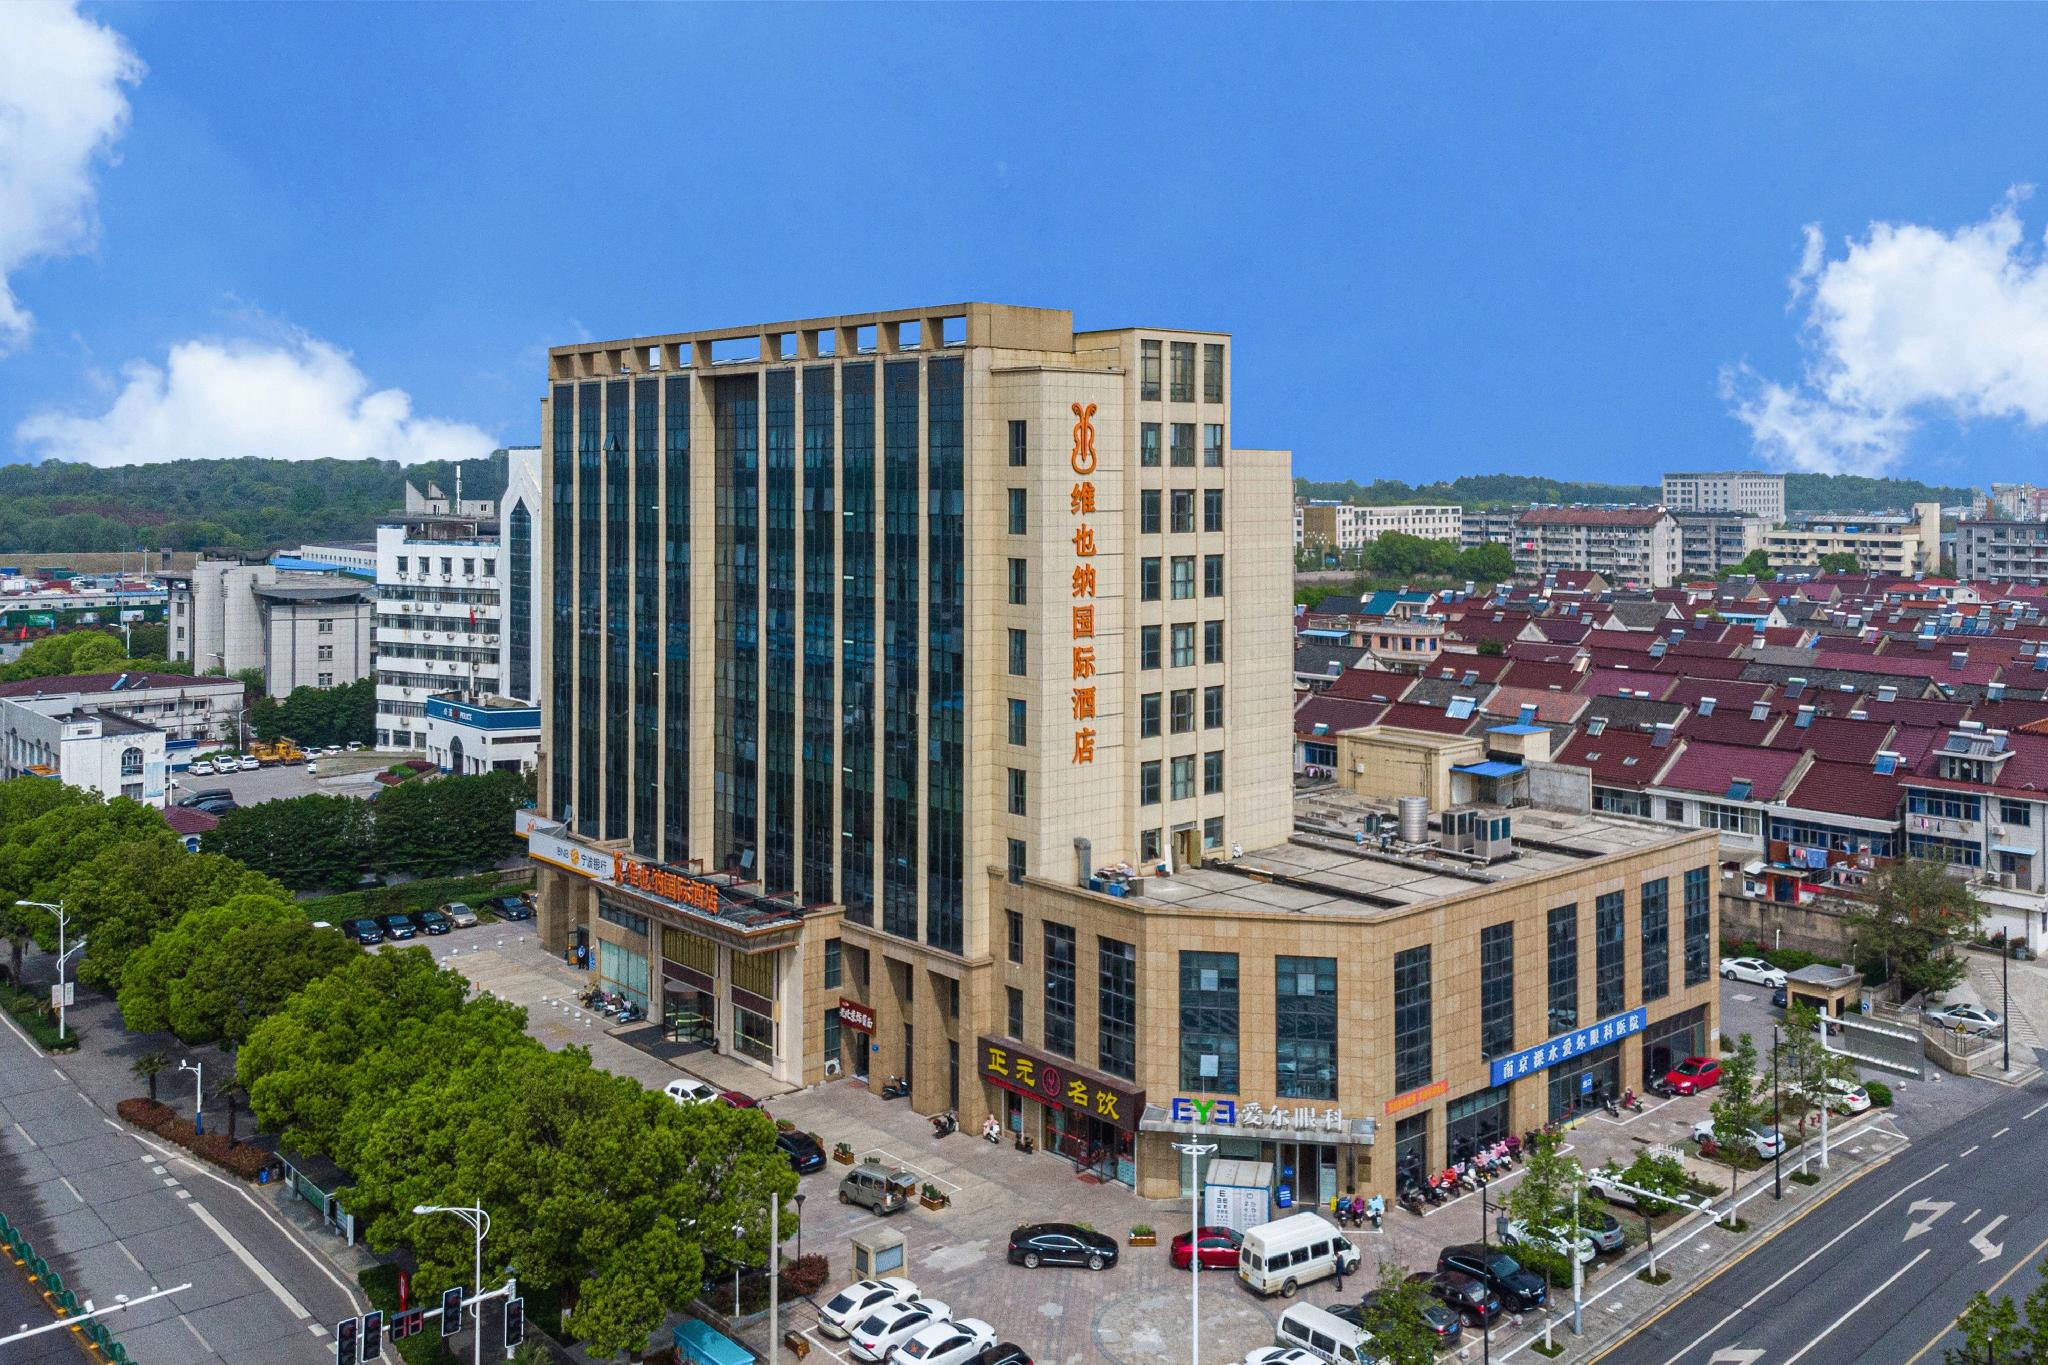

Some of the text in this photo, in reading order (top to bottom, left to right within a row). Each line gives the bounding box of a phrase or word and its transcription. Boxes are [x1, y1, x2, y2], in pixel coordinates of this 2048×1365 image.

[1071, 481, 1096, 765] 维也纳国际酒店
[581, 854, 607, 873] 宁波银行
[627, 860, 719, 914] 维也纳国际酒店
[1503, 1015, 1639, 1079] 南京溧水爱尔眼科医院
[988, 1047, 1120, 1120] 正元 名饮
[1242, 1102, 1342, 1131] 爱尔眼科
